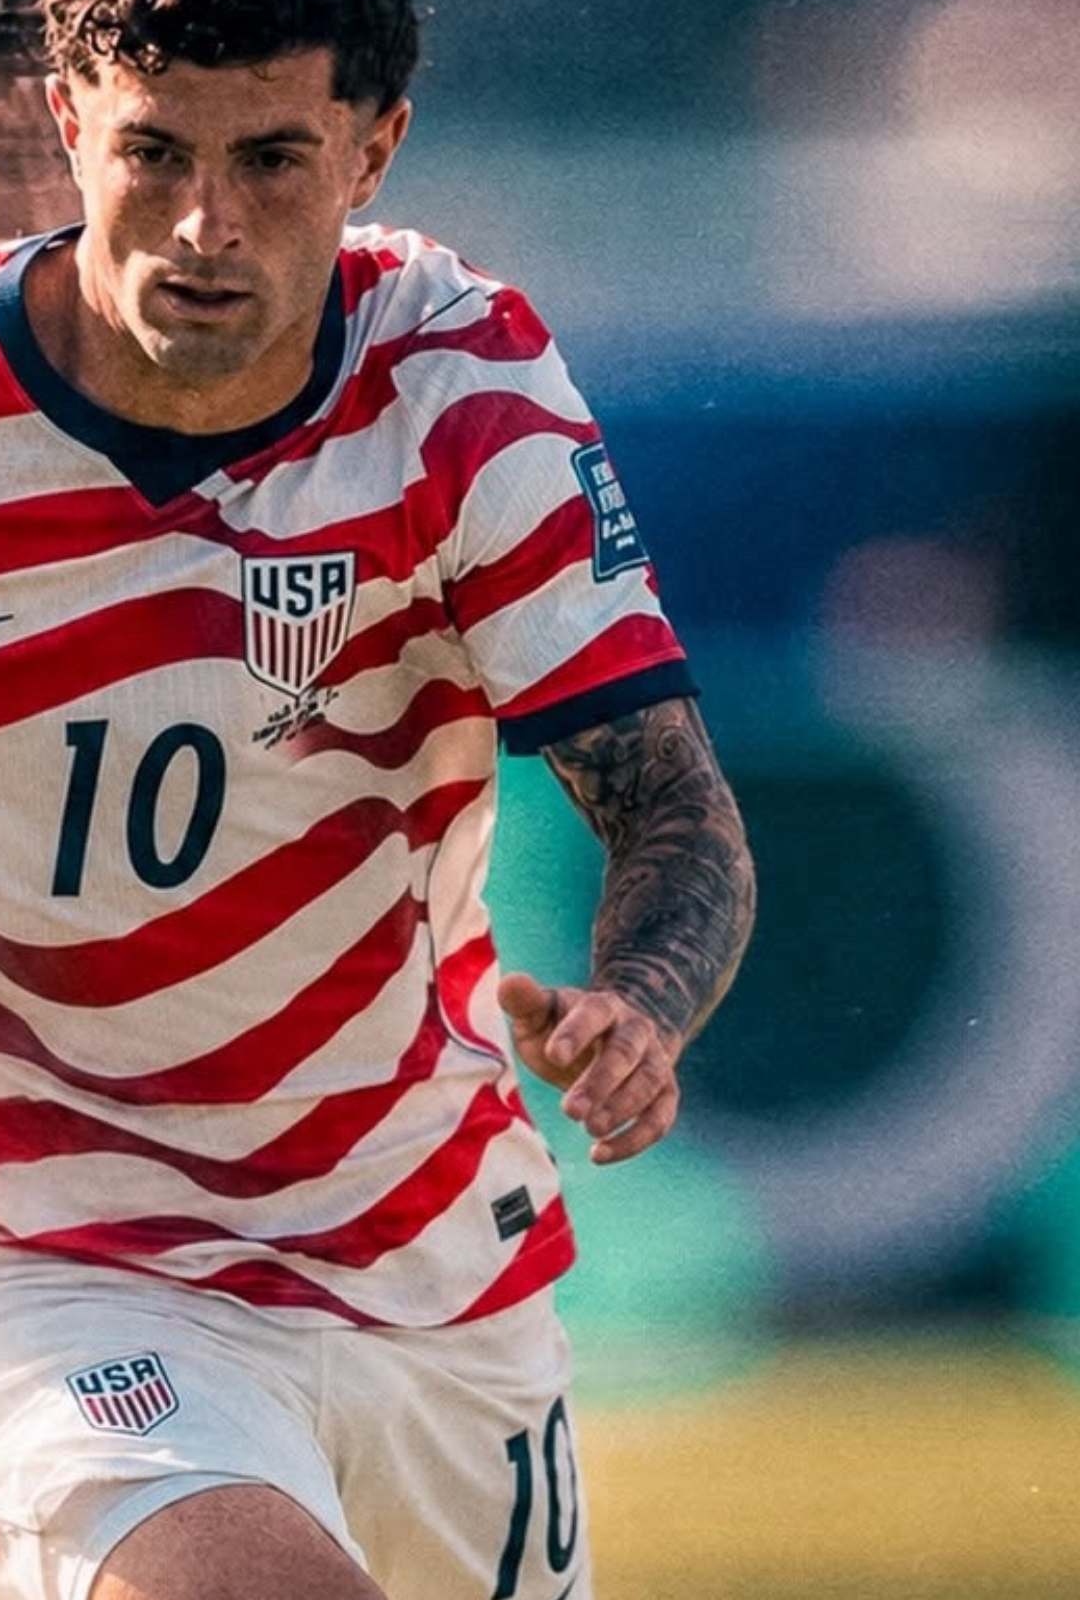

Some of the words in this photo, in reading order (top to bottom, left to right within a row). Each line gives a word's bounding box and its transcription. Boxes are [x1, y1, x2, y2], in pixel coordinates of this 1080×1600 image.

[252, 560, 347, 618] USA
[51, 719, 227, 897] 10
[75, 1358, 157, 1394] USA
